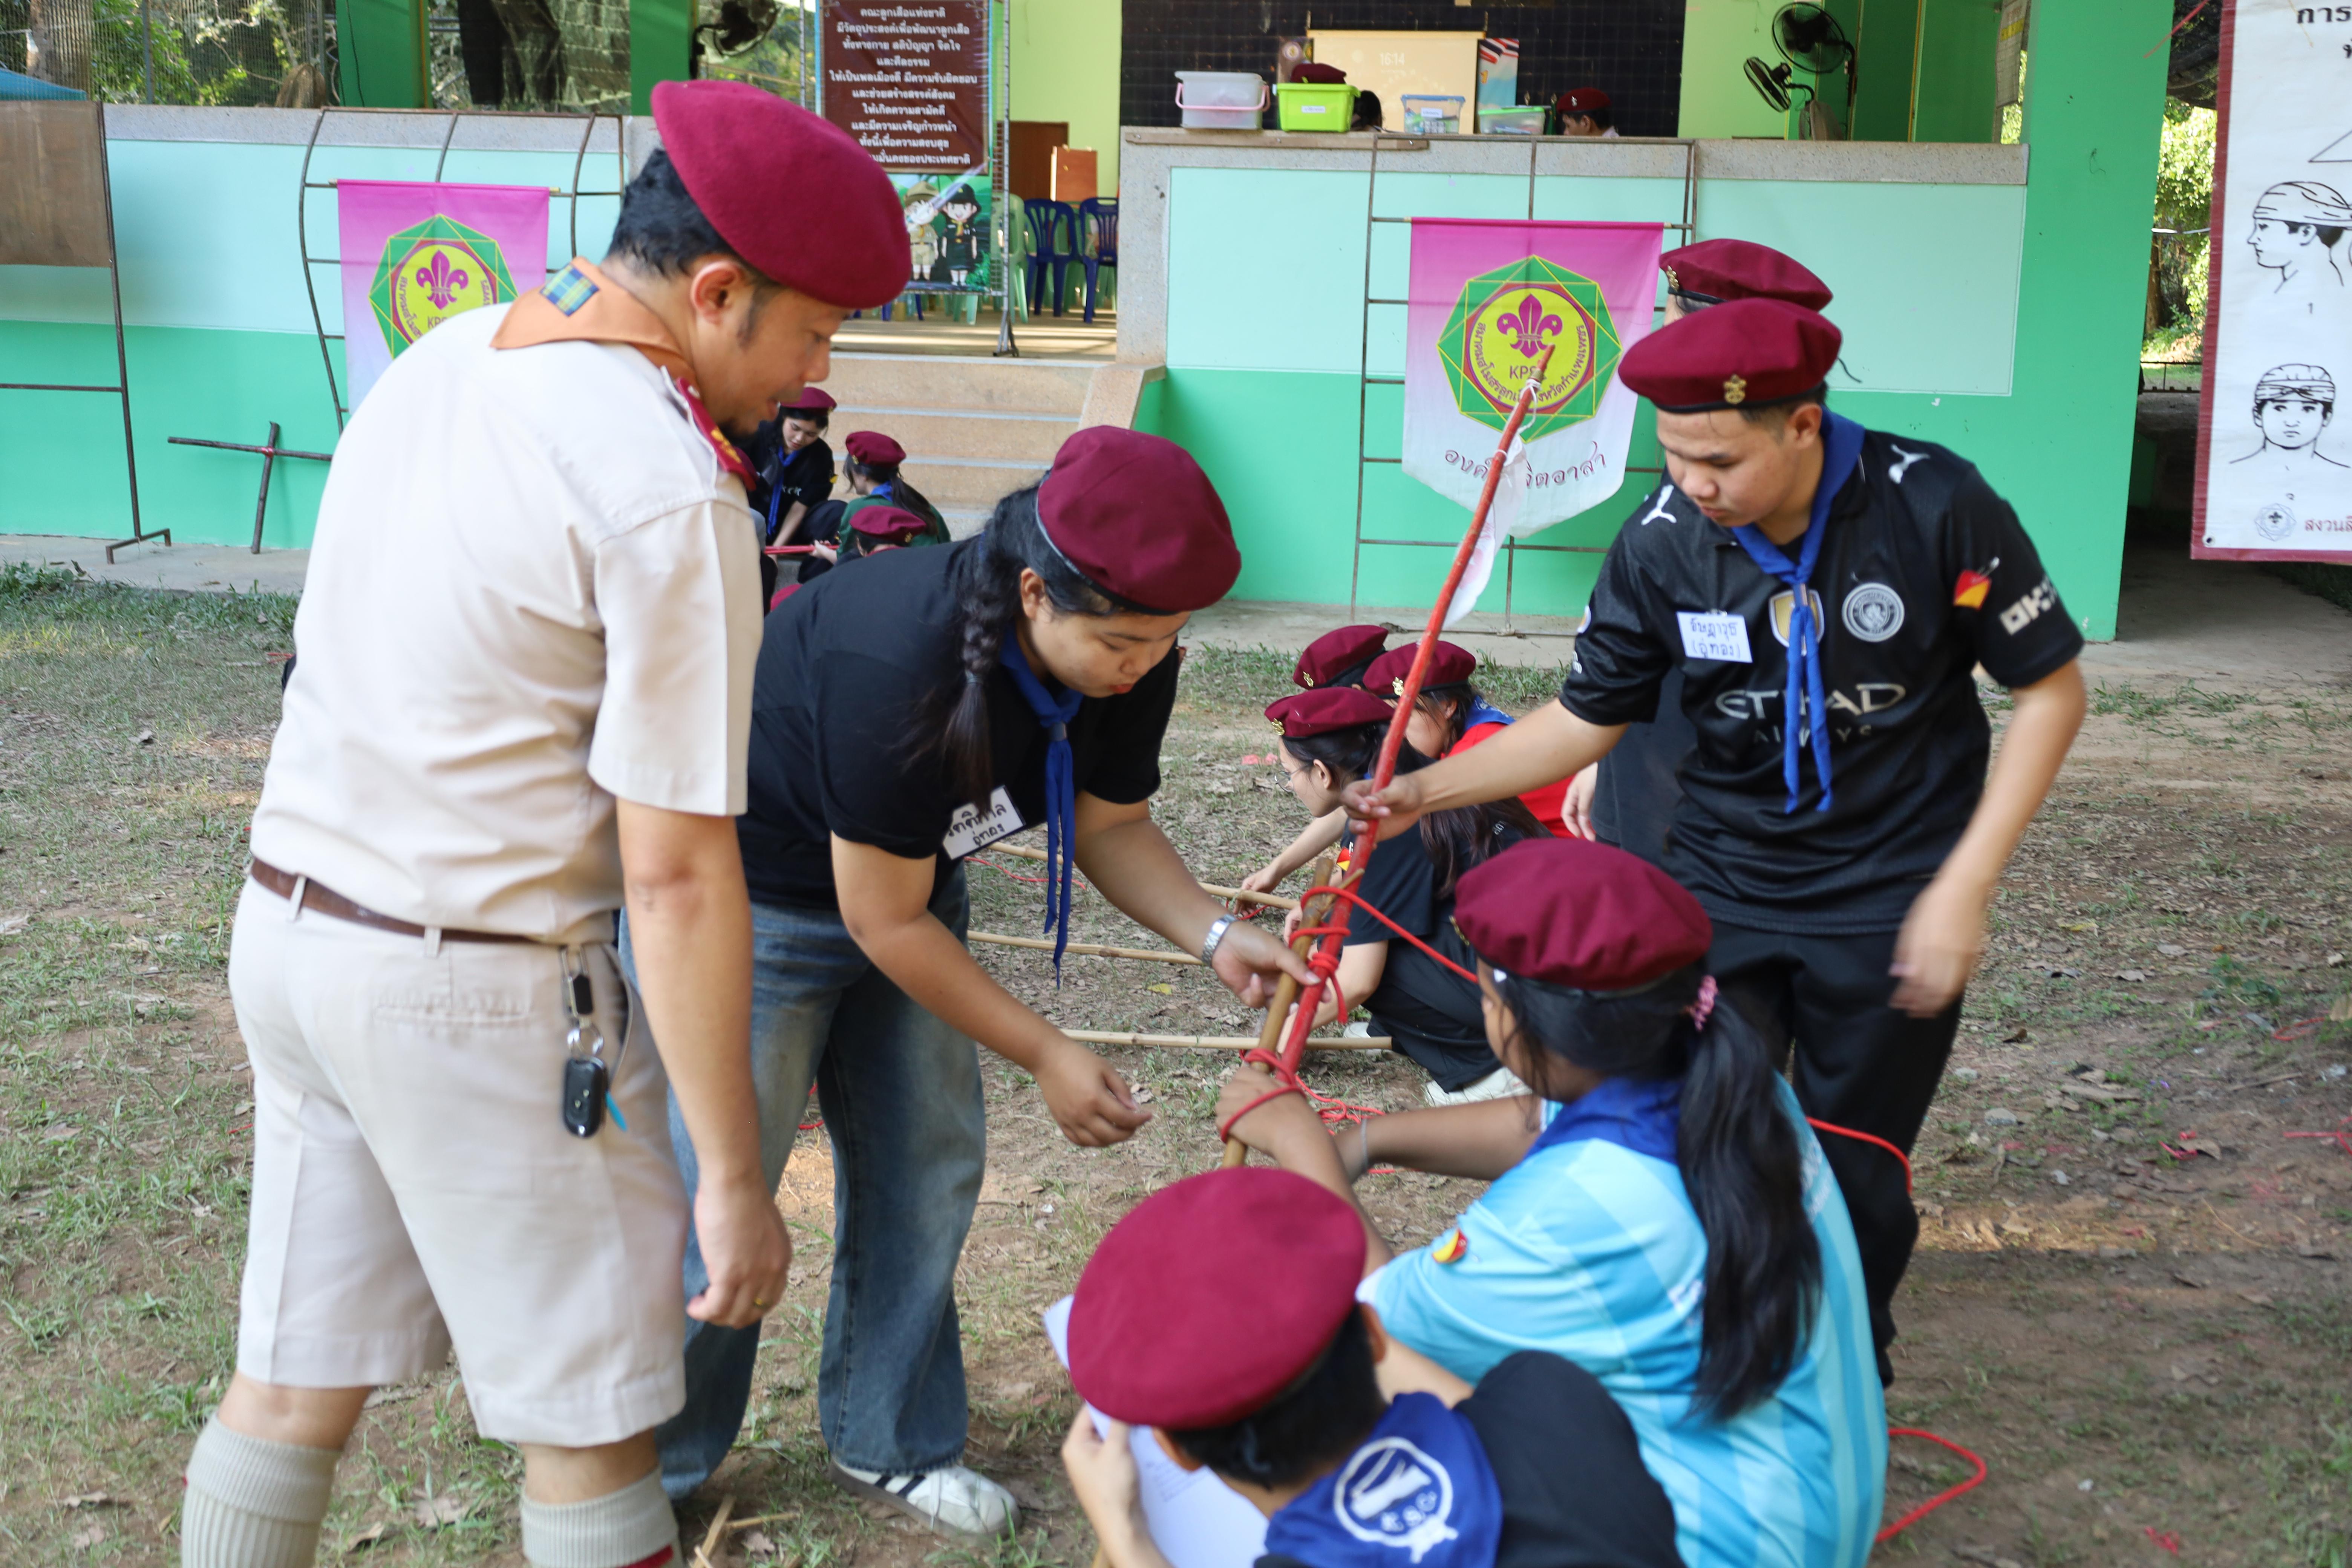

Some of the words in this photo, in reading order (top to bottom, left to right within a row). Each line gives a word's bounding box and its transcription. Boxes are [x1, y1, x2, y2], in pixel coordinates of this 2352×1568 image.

[860, 5, 946, 21] คณะลูกเสือแห่งชาติ
[837, 20, 970, 38] มีวัตถุประสงค์เพื่อพัฒนาลูกเสือ
[842, 34, 890, 50] ทั้งทางกาย
[892, 39, 935, 53] สติปัญญา
[937, 38, 961, 51] จิตใจ
[876, 55, 930, 67] และศีลธรรม
[1379, 51, 1406, 66] 16:14
[828, 69, 902, 83] ให้เป็นพลเมืองดี
[903, 71, 978, 84] มีความรับผิดชอบ
[852, 87, 956, 100] และช่วยสร้างสรรค์สังคม
[862, 102, 945, 115] ให้เกิดความสามัคคี
[851, 119, 957, 133] และมีความเจริญก้าวหน้า
[858, 132, 949, 151] ทั้งนี้เพื่อความสงบสุข
[1715, 682, 1906, 720] ETAD
